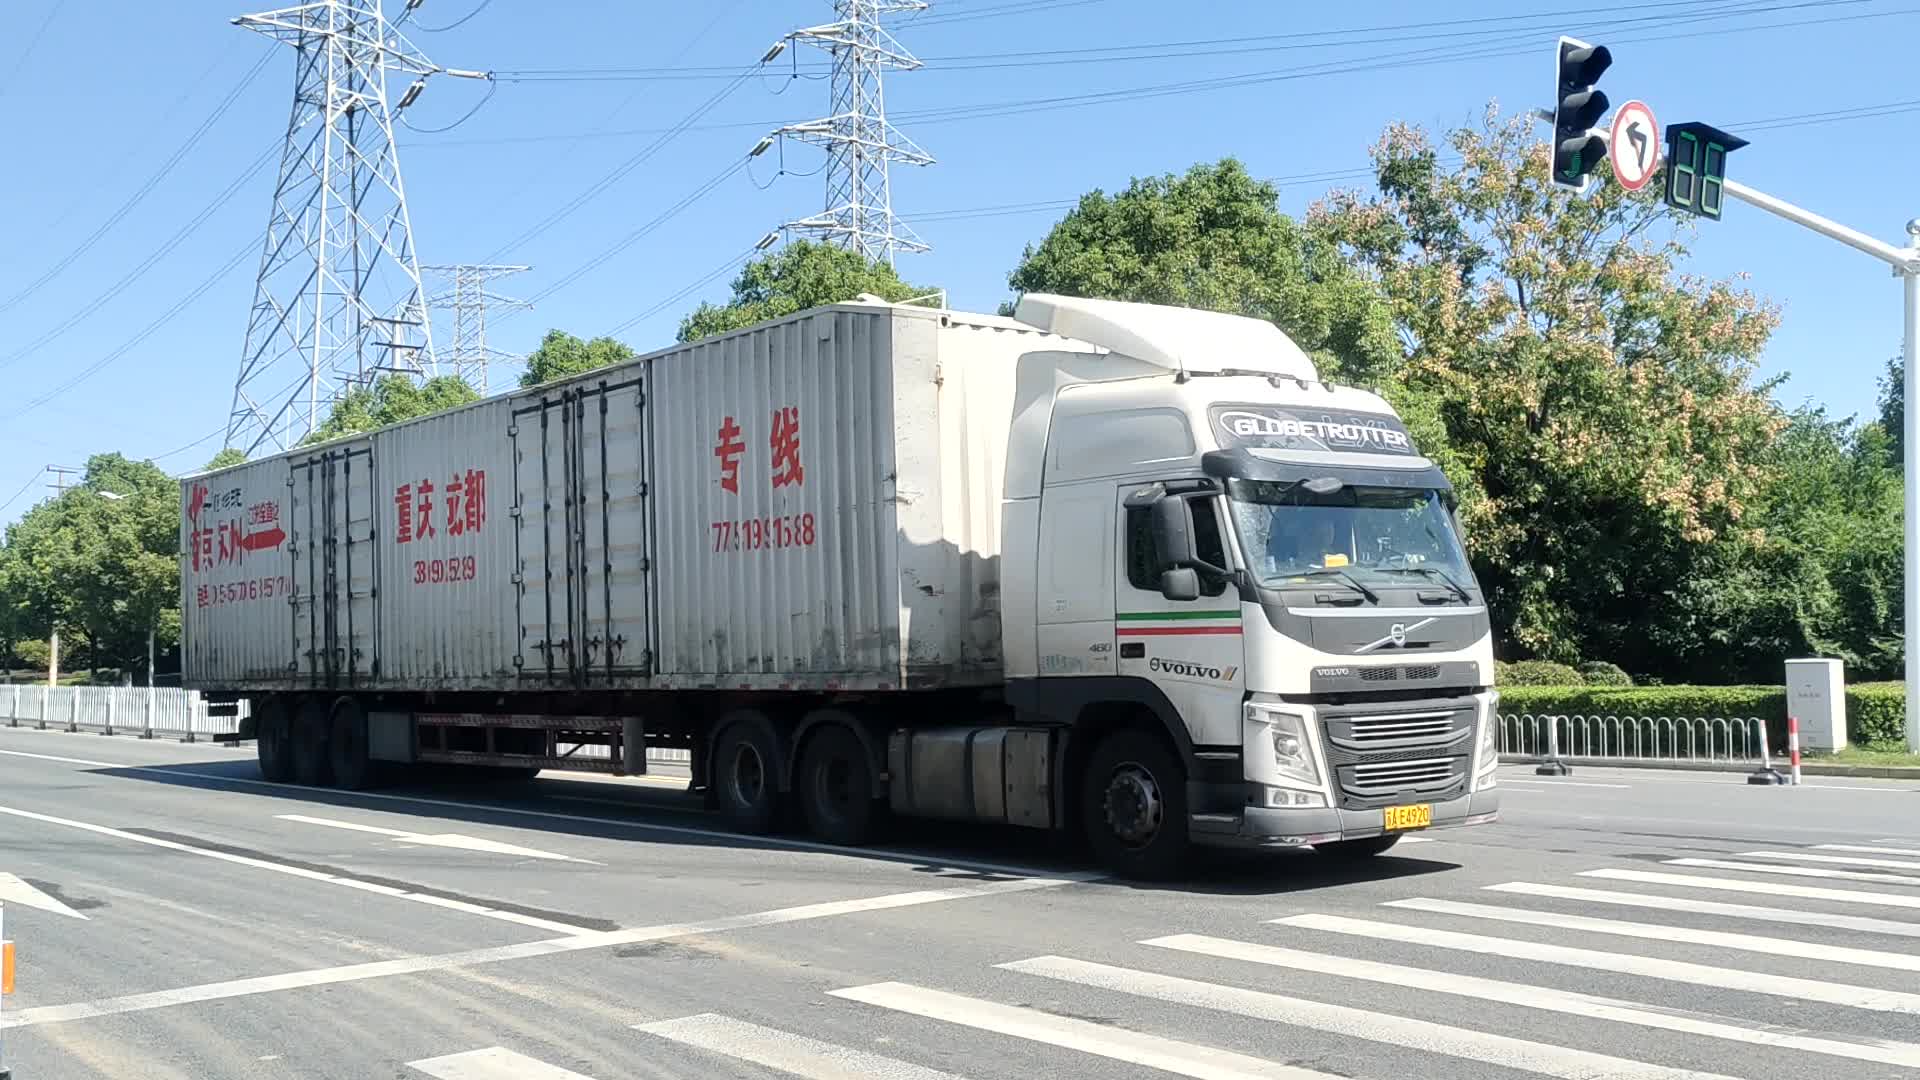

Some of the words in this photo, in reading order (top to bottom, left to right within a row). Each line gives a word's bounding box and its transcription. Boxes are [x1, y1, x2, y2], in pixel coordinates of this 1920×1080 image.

[1234, 418, 1409, 448] GLOBETROTTER
[714, 407, 804, 496] 专线
[1160, 662, 1220, 679] VOLVO
[1317, 668, 1349, 676] VOLVO
